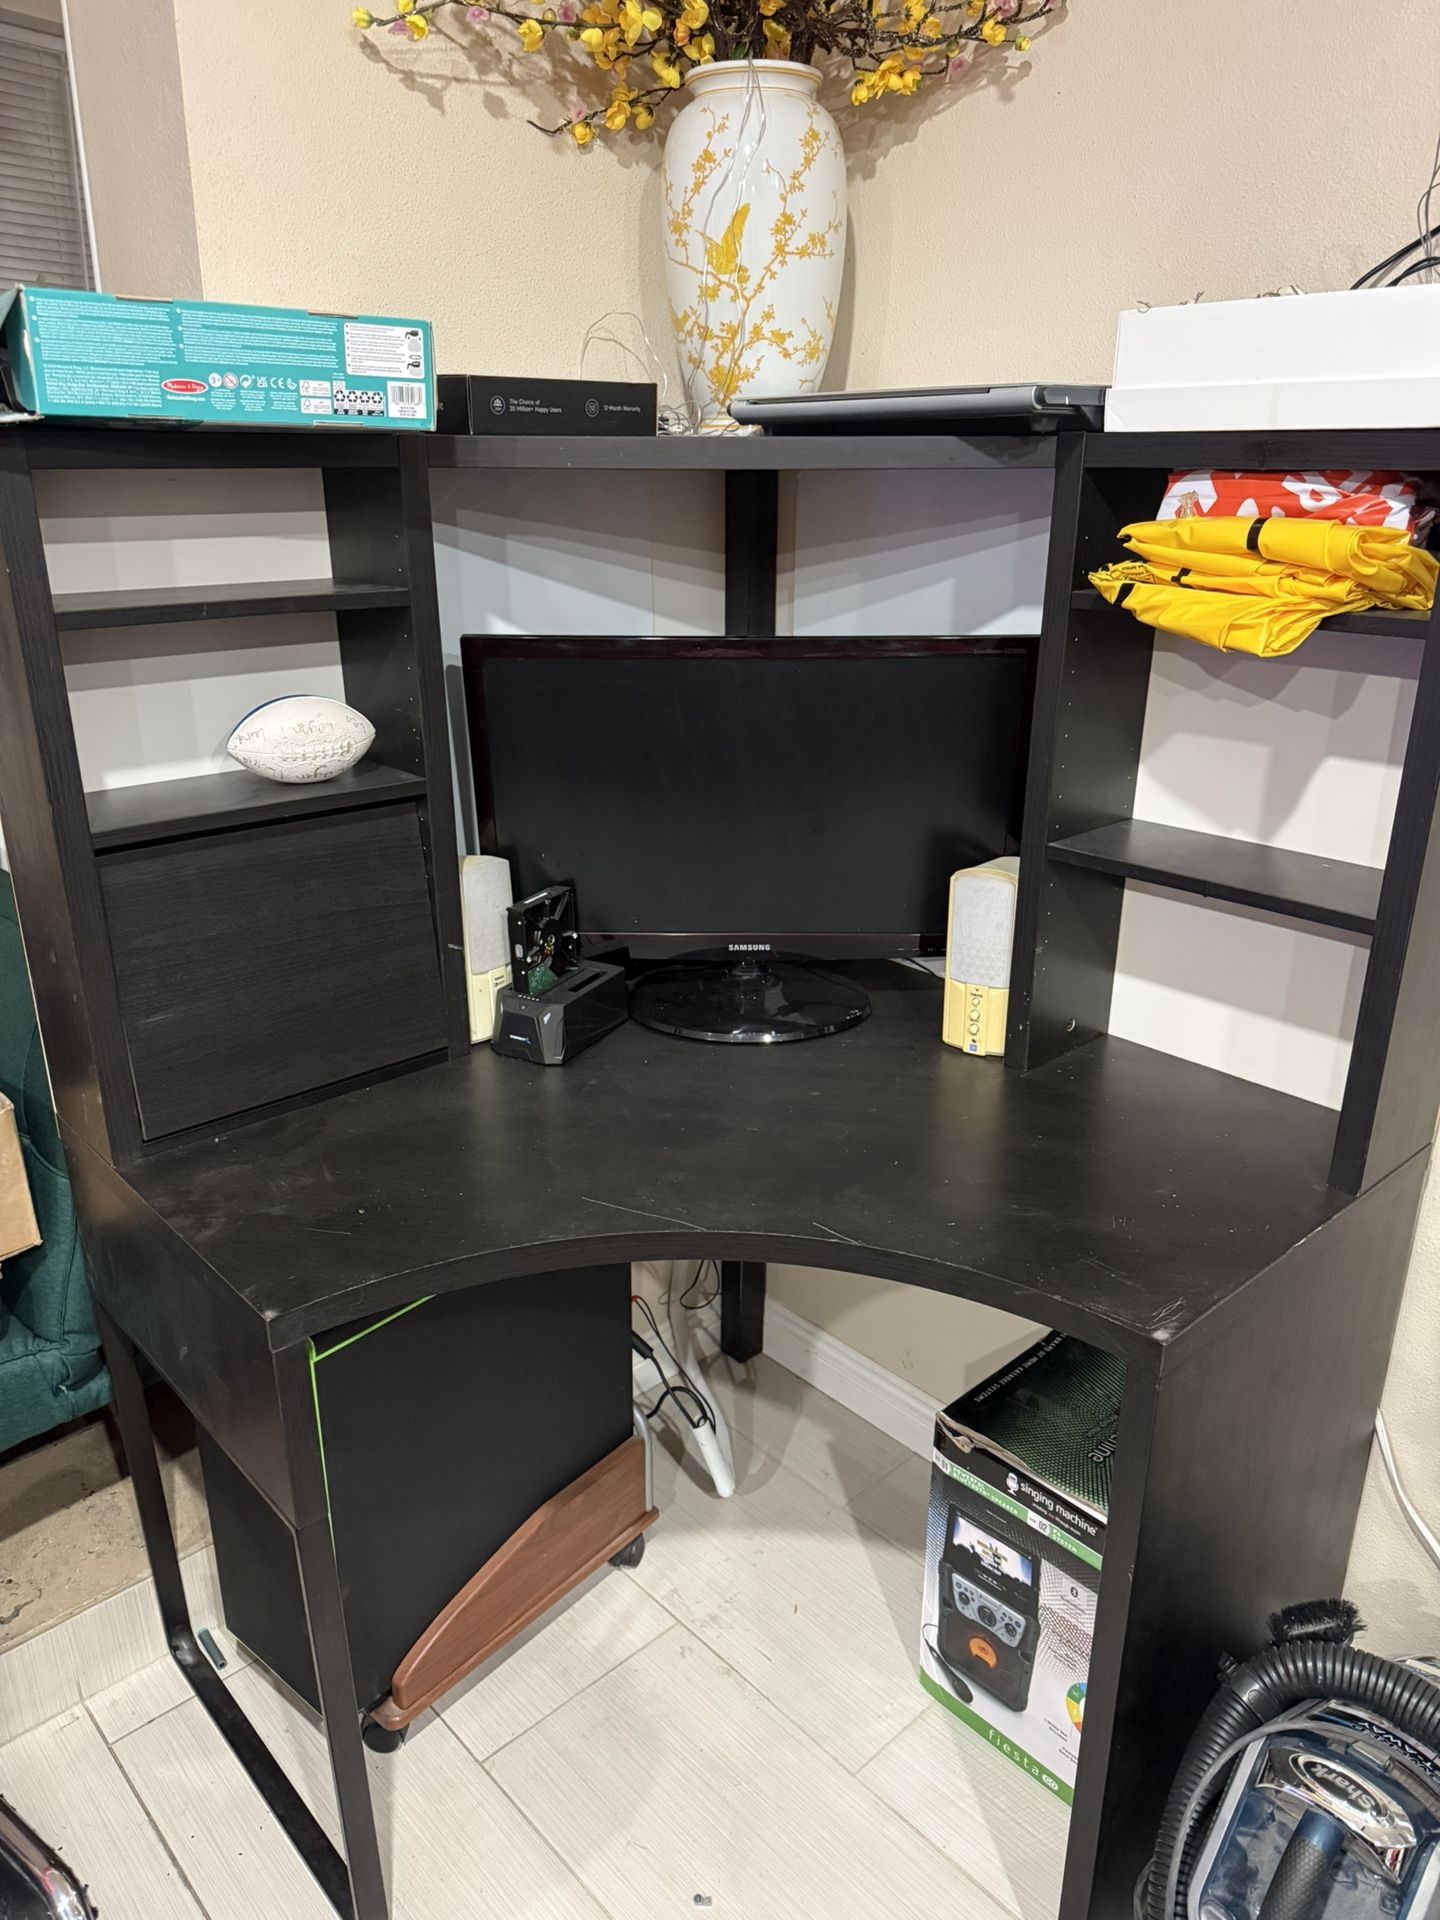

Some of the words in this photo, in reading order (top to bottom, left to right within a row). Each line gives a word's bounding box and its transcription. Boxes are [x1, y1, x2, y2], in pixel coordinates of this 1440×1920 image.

[534, 406, 549, 414] Happy
[1022, 1356, 1039, 1369] HOME
[998, 1366, 1024, 1385] KARAOKE
[974, 1383, 1001, 1403] SYSTEMS
[953, 1467, 985, 1489] POWERFUL
[990, 1494, 1018, 1514] SPEAKER
[1020, 1482, 1054, 1510] singing
[1055, 1503, 1096, 1537] machine
[1038, 1520, 1048, 1533] 02
[1053, 1533, 1077, 1554] SYSTEM
[988, 1729, 1039, 1776] fiesta
[1311, 1764, 1376, 1810] Shark
